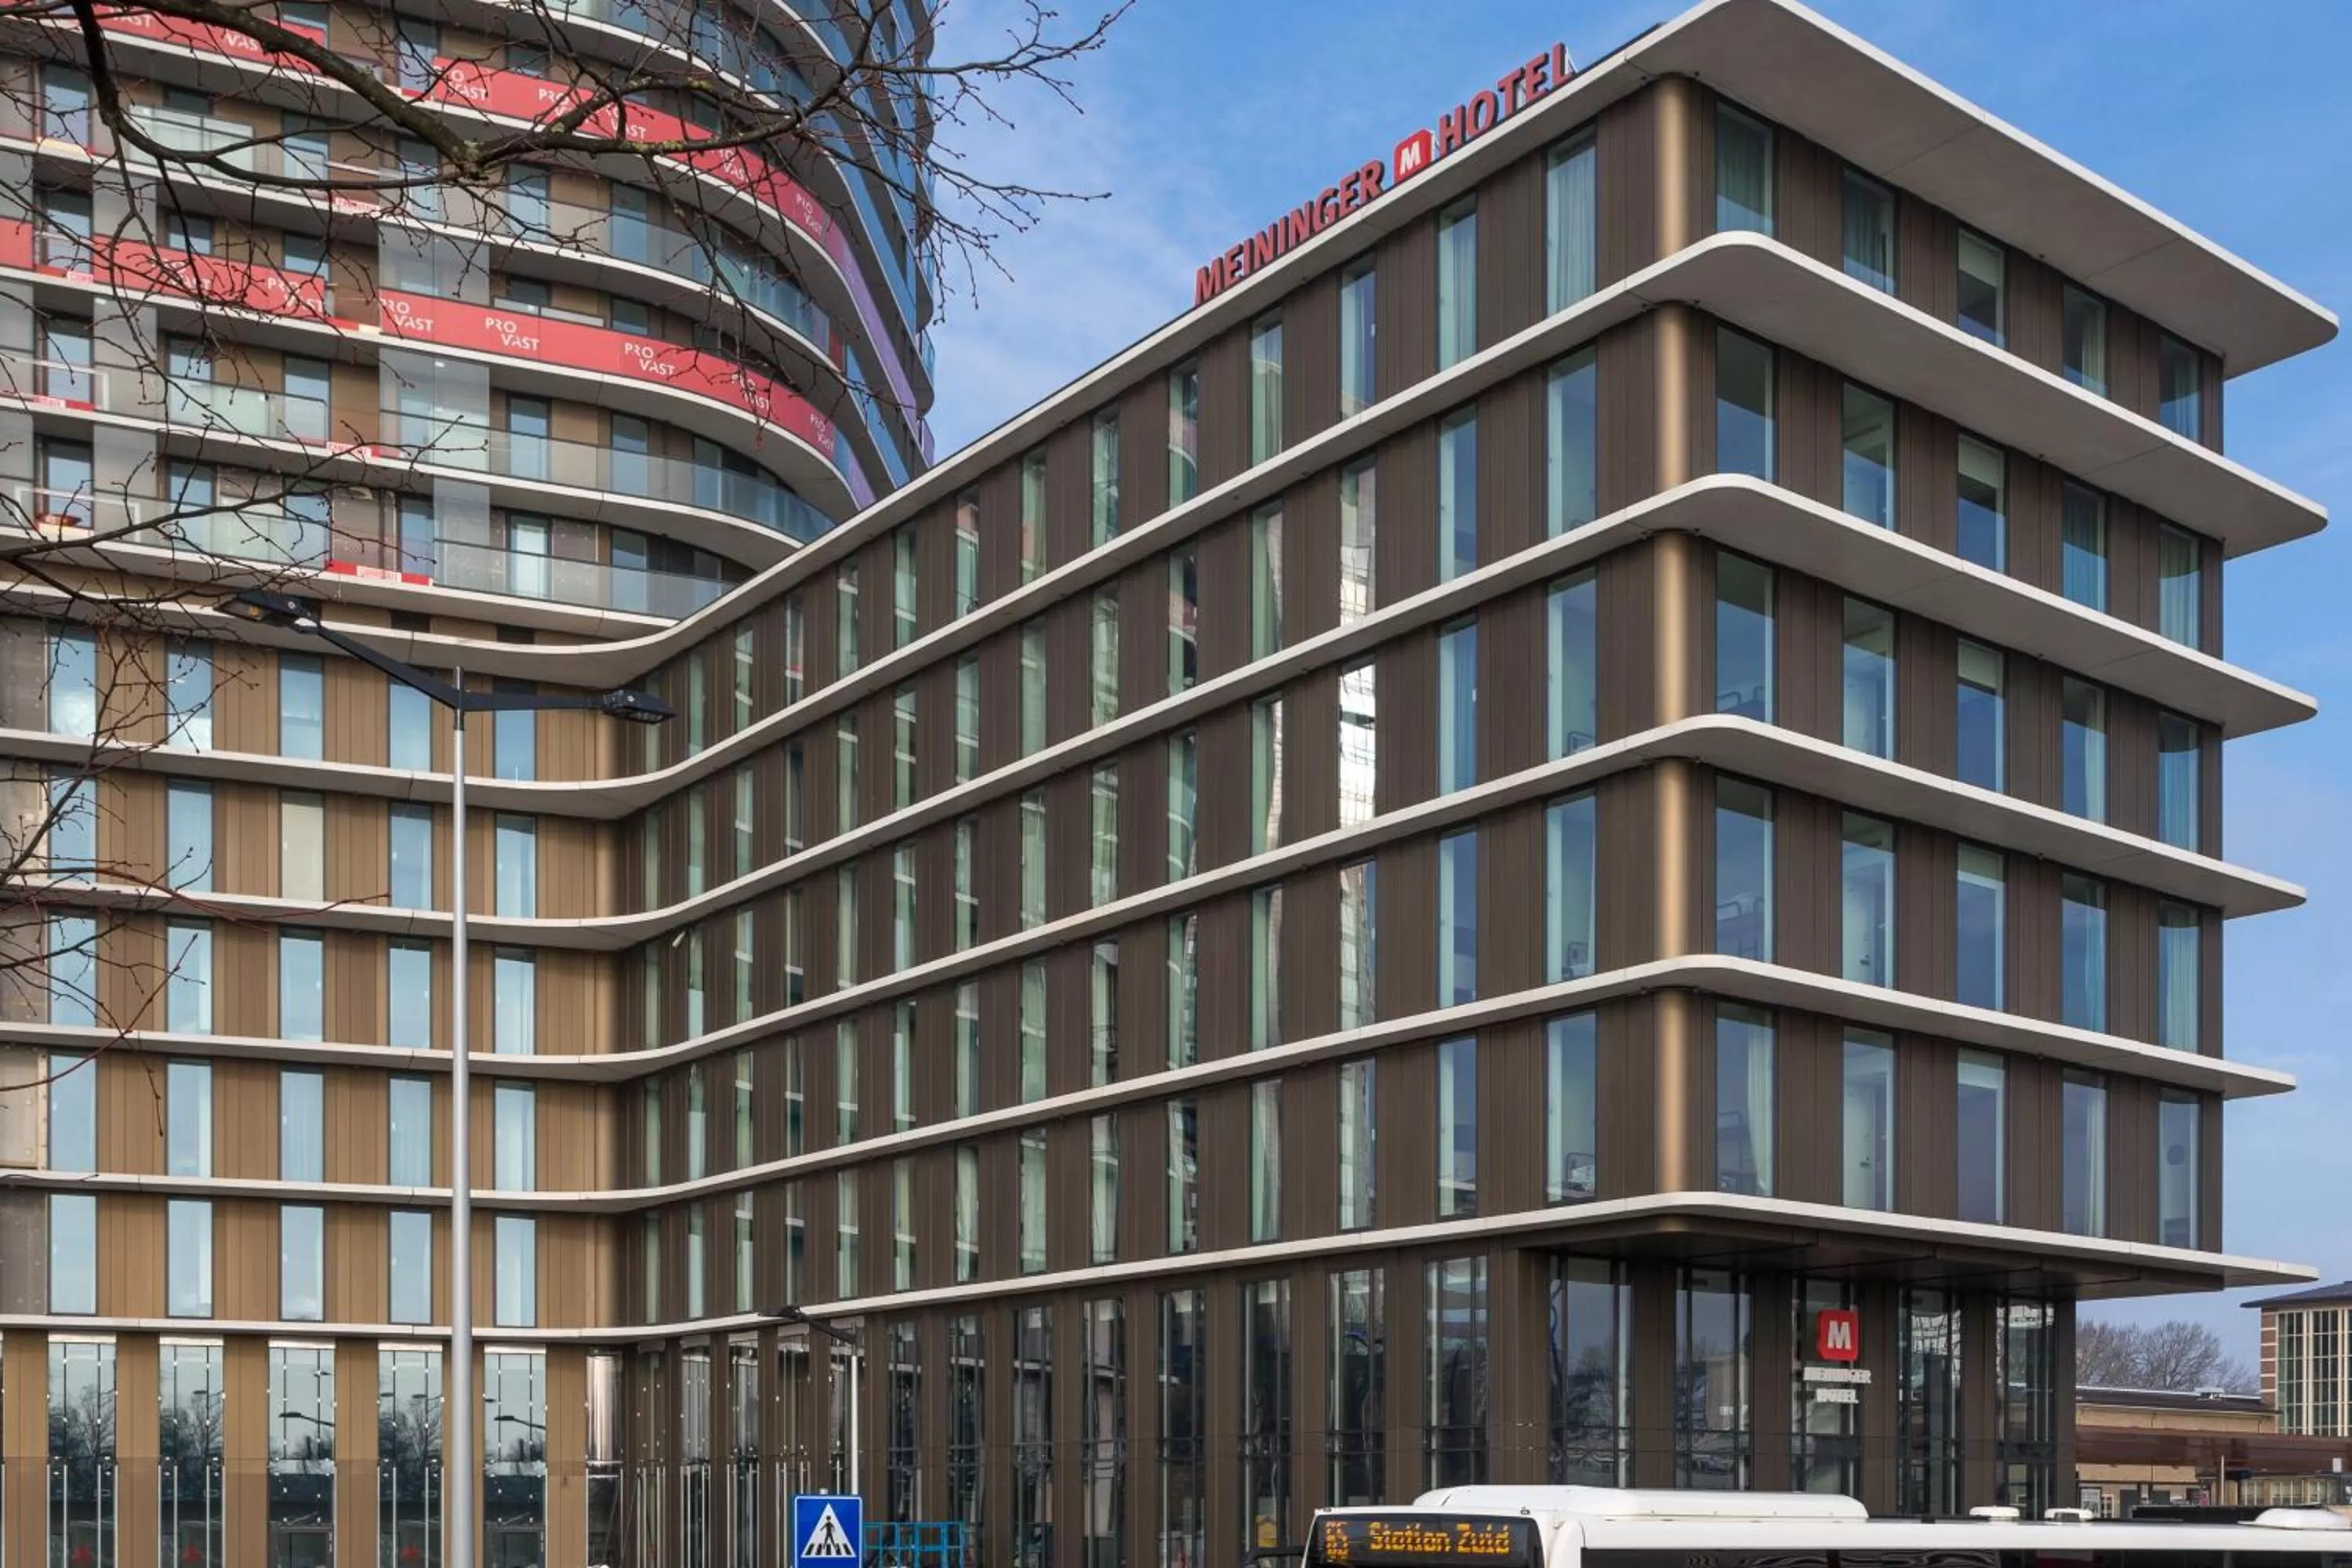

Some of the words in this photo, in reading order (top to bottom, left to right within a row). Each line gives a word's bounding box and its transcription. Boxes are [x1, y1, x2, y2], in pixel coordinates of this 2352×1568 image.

[226, 32, 260, 51] VAS
[611, 118, 646, 139] VST
[1194, 159, 1385, 307] MEININGER
[1399, 140, 1422, 174] M
[1439, 42, 1574, 156] HOTEL
[394, 314, 433, 332] VAST
[485, 317, 517, 333] PRO
[501, 333, 539, 350] VAST
[624, 342, 654, 358] PRO
[640, 358, 676, 376] VAST
[1827, 1319, 1852, 1350] M
[1369, 1522, 1452, 1552] Station
[1456, 1523, 1510, 1554] Zuid
